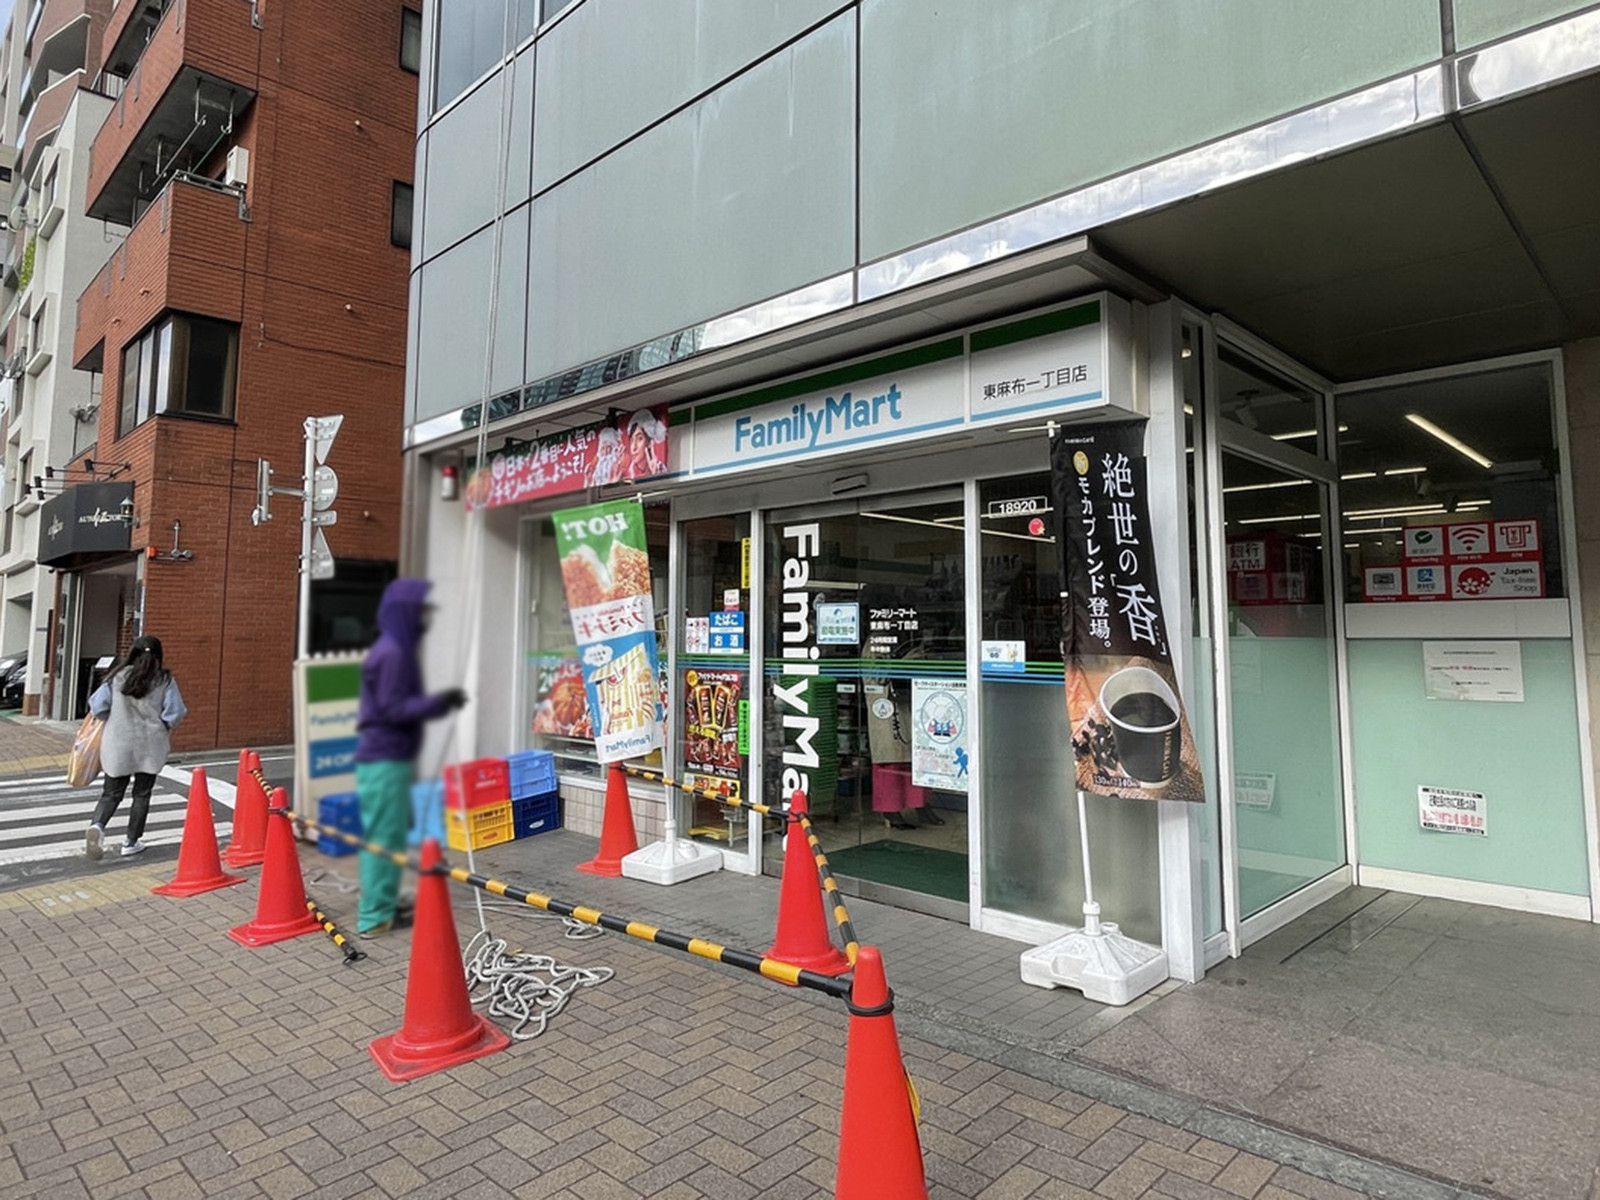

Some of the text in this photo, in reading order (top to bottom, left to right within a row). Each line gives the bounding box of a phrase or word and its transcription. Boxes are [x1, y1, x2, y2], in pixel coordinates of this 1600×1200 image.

[983, 364, 1088, 400] 東麻布一丁目店
[735, 383, 903, 452] FamilyMart
[999, 500, 1037, 515] 18920
[774, 523, 820, 852] FamilyMa
